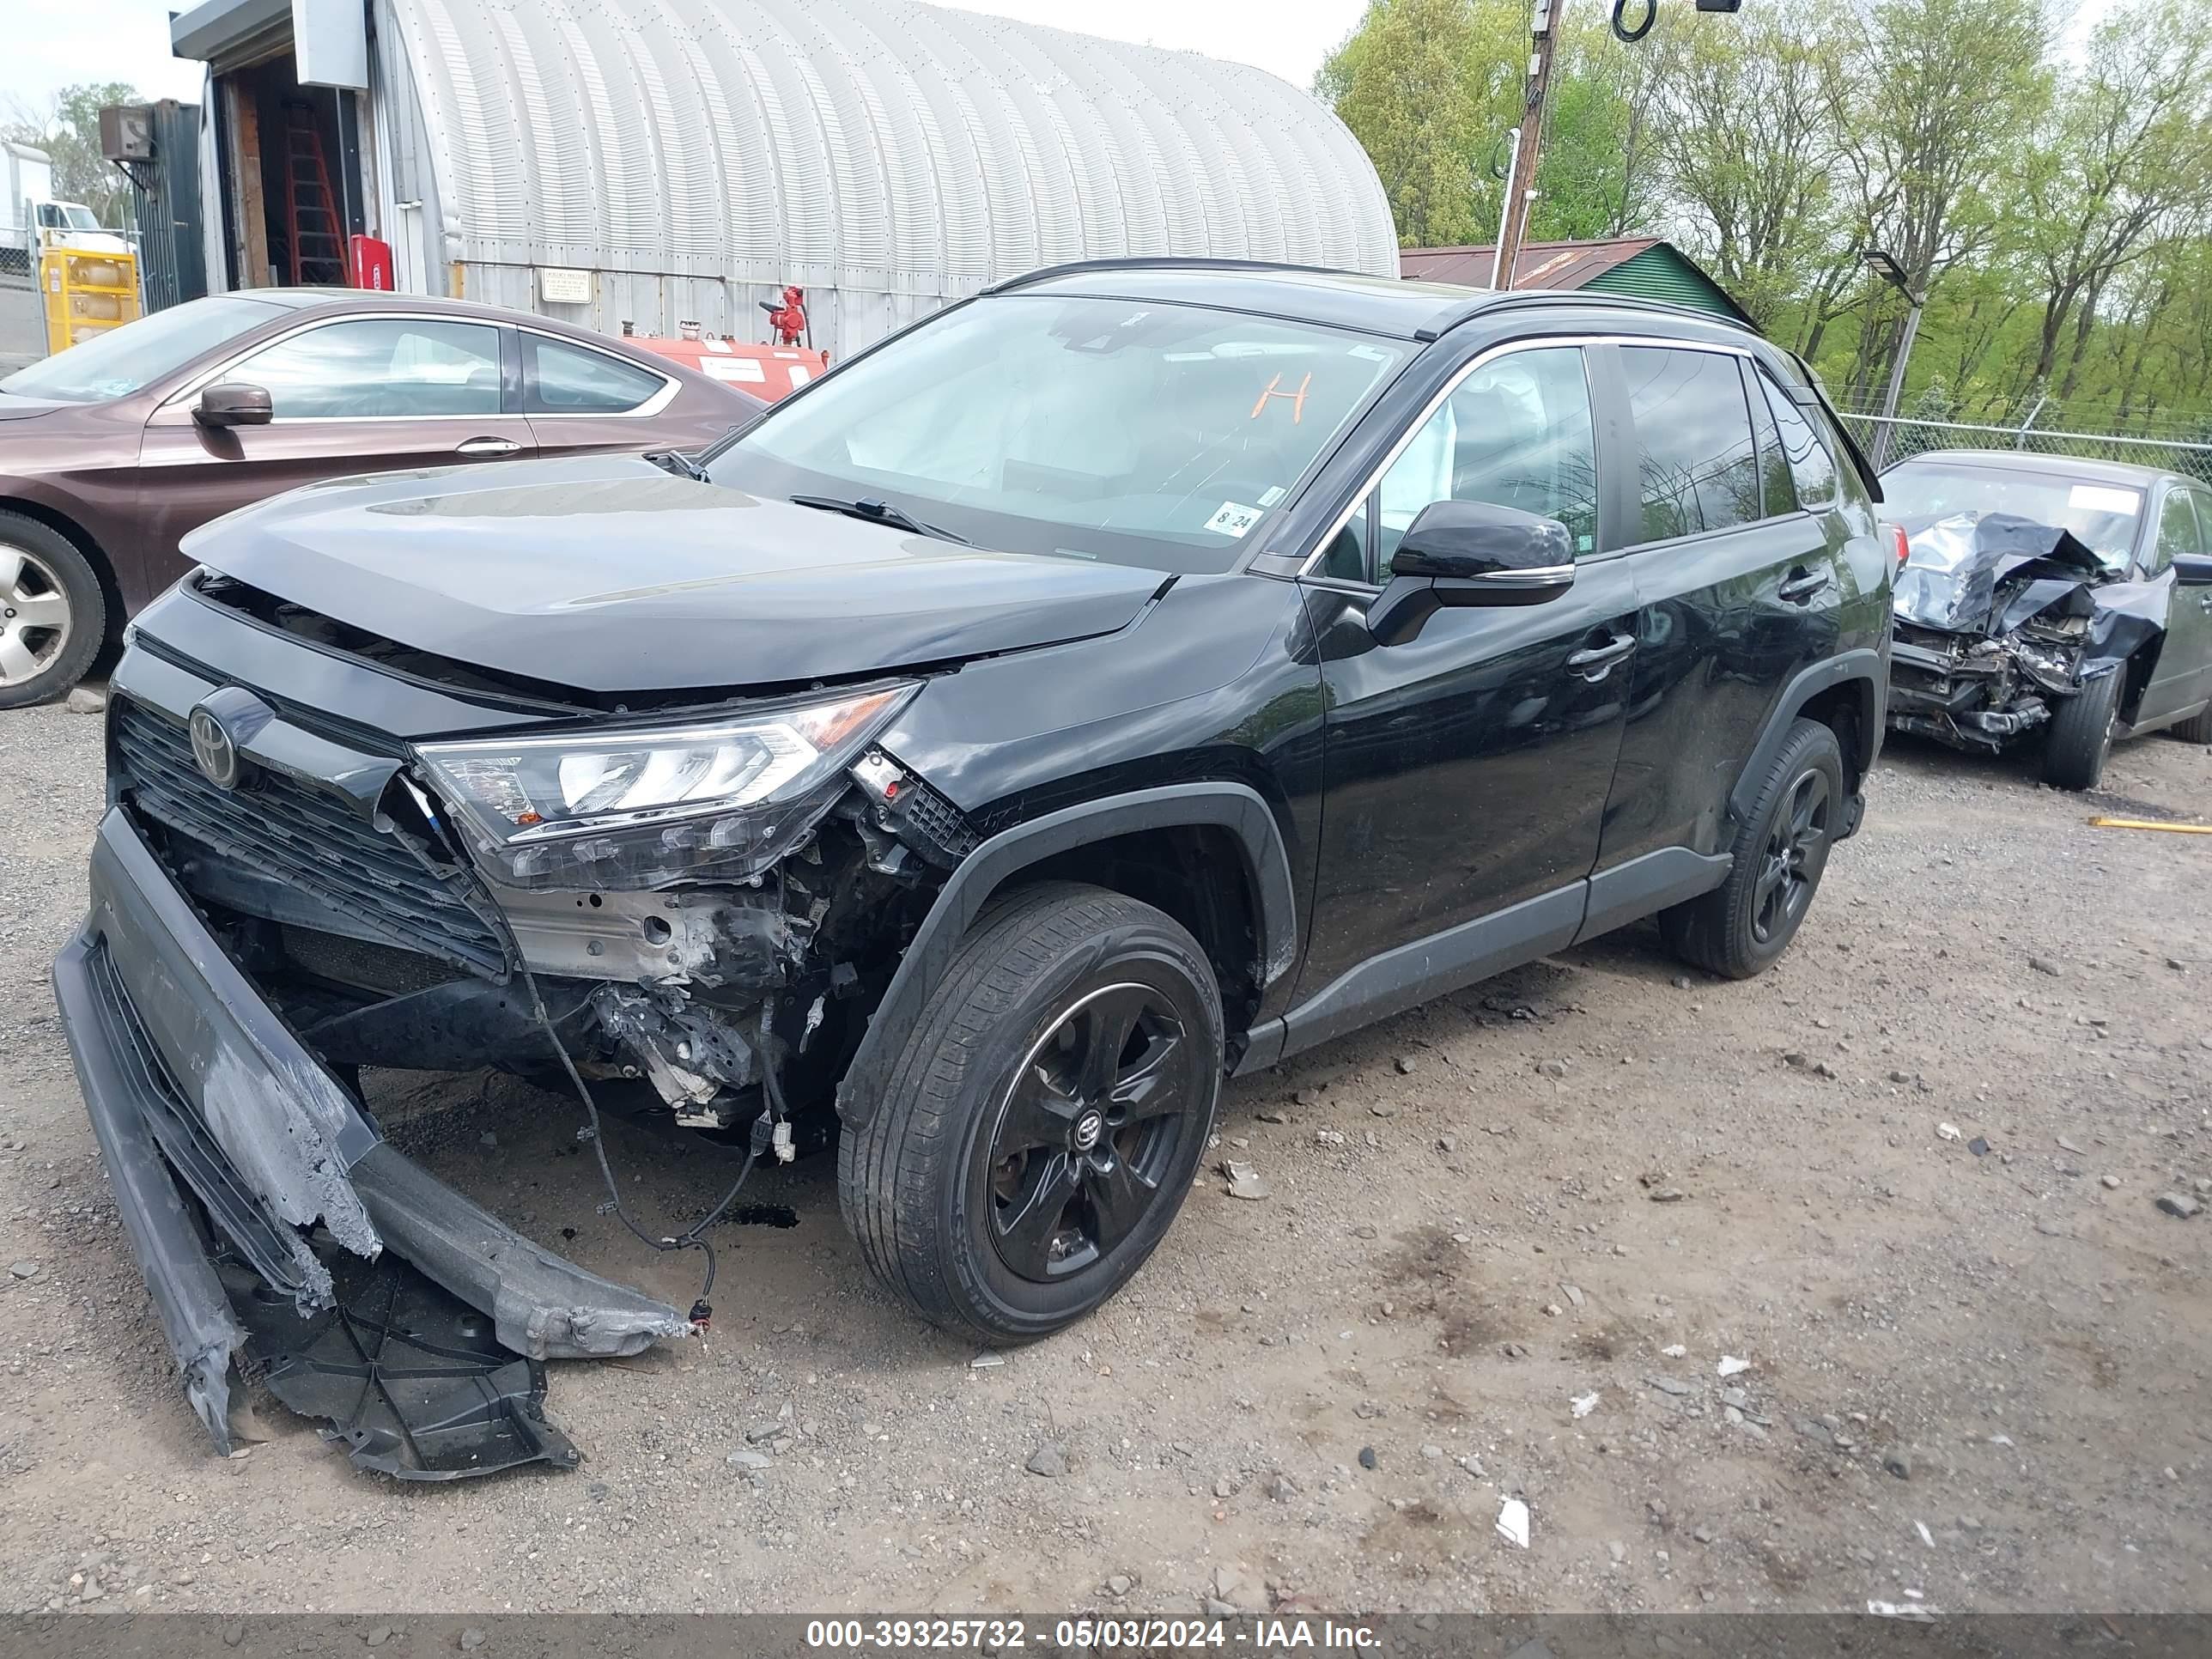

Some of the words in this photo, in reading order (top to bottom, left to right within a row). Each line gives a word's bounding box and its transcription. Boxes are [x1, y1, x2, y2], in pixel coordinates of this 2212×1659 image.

[1251, 372, 1311, 424] H
[1217, 512, 1231, 523] 8
[1231, 515, 1252, 529] 24
